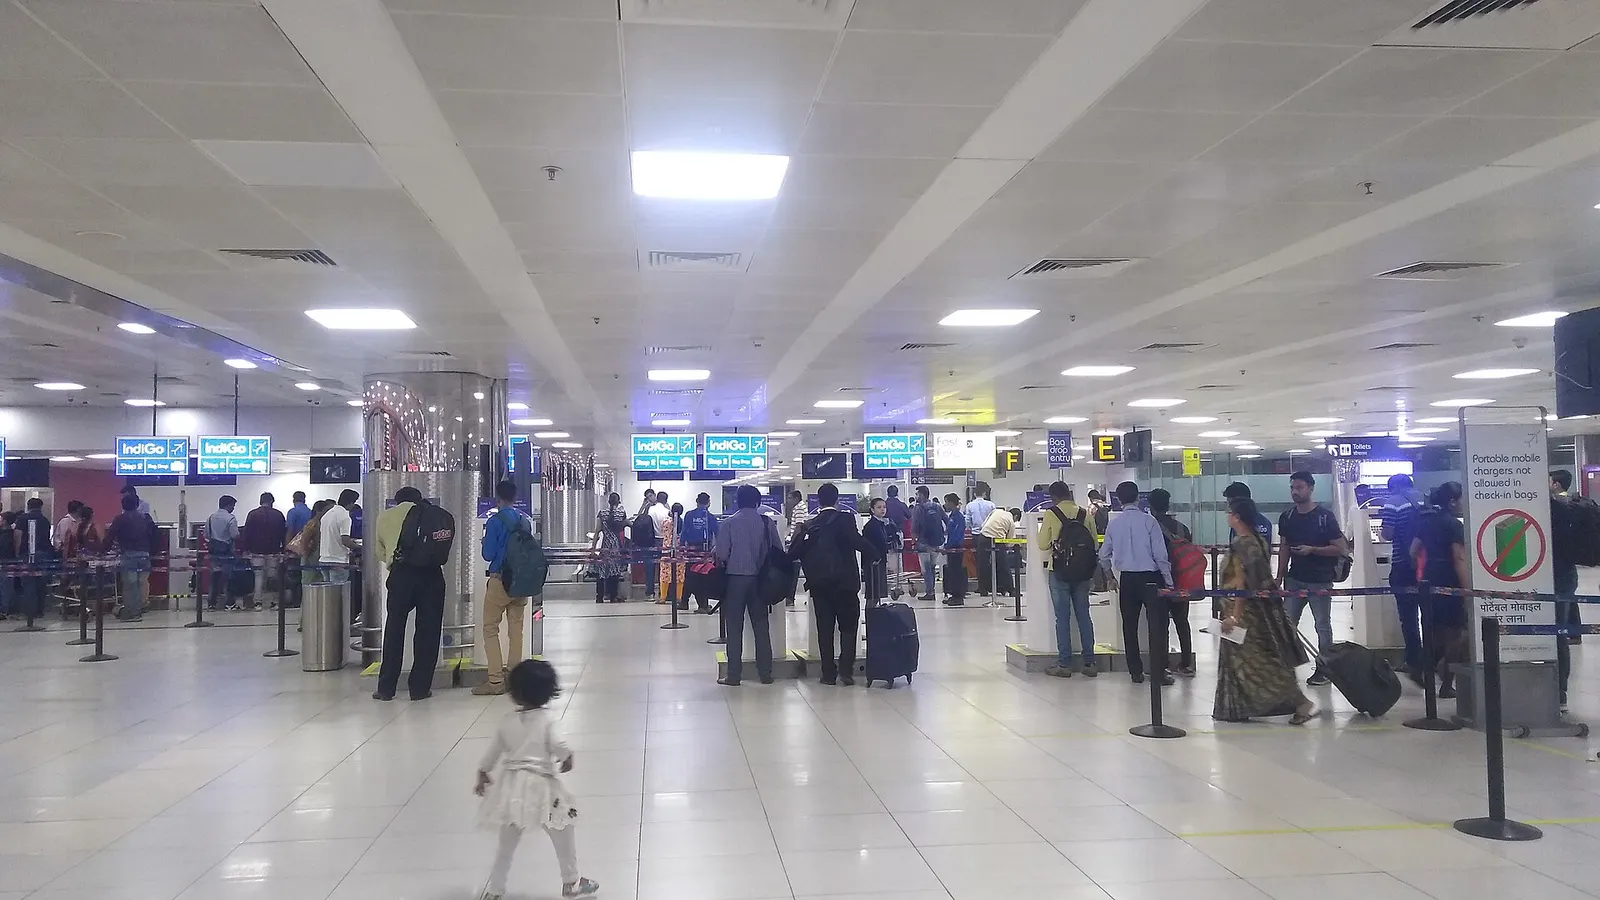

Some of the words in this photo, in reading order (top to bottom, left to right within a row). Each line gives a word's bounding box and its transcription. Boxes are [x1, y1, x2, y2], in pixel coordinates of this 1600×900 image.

[205, 442, 247, 454] IndiGo
[637, 440, 675, 452] IndiGo
[709, 439, 747, 451] IndiGo
[869, 439, 906, 451] IndiGo
[1050, 437, 1066, 448] Bag
[122, 443, 165, 454] IndiGo
[1050, 446, 1068, 455] drop
[1098, 437, 1115, 460] E
[1007, 452, 1018, 470] F
[1050, 455, 1070, 463] entry
[1473, 454, 1509, 463] Portable
[1511, 453, 1541, 463] mobile
[1473, 467, 1513, 477] chargers
[1516, 467, 1531, 475] not
[1474, 478, 1510, 487] allowed
[1474, 491, 1511, 499] check-in
[1514, 490, 1538, 501] bags
